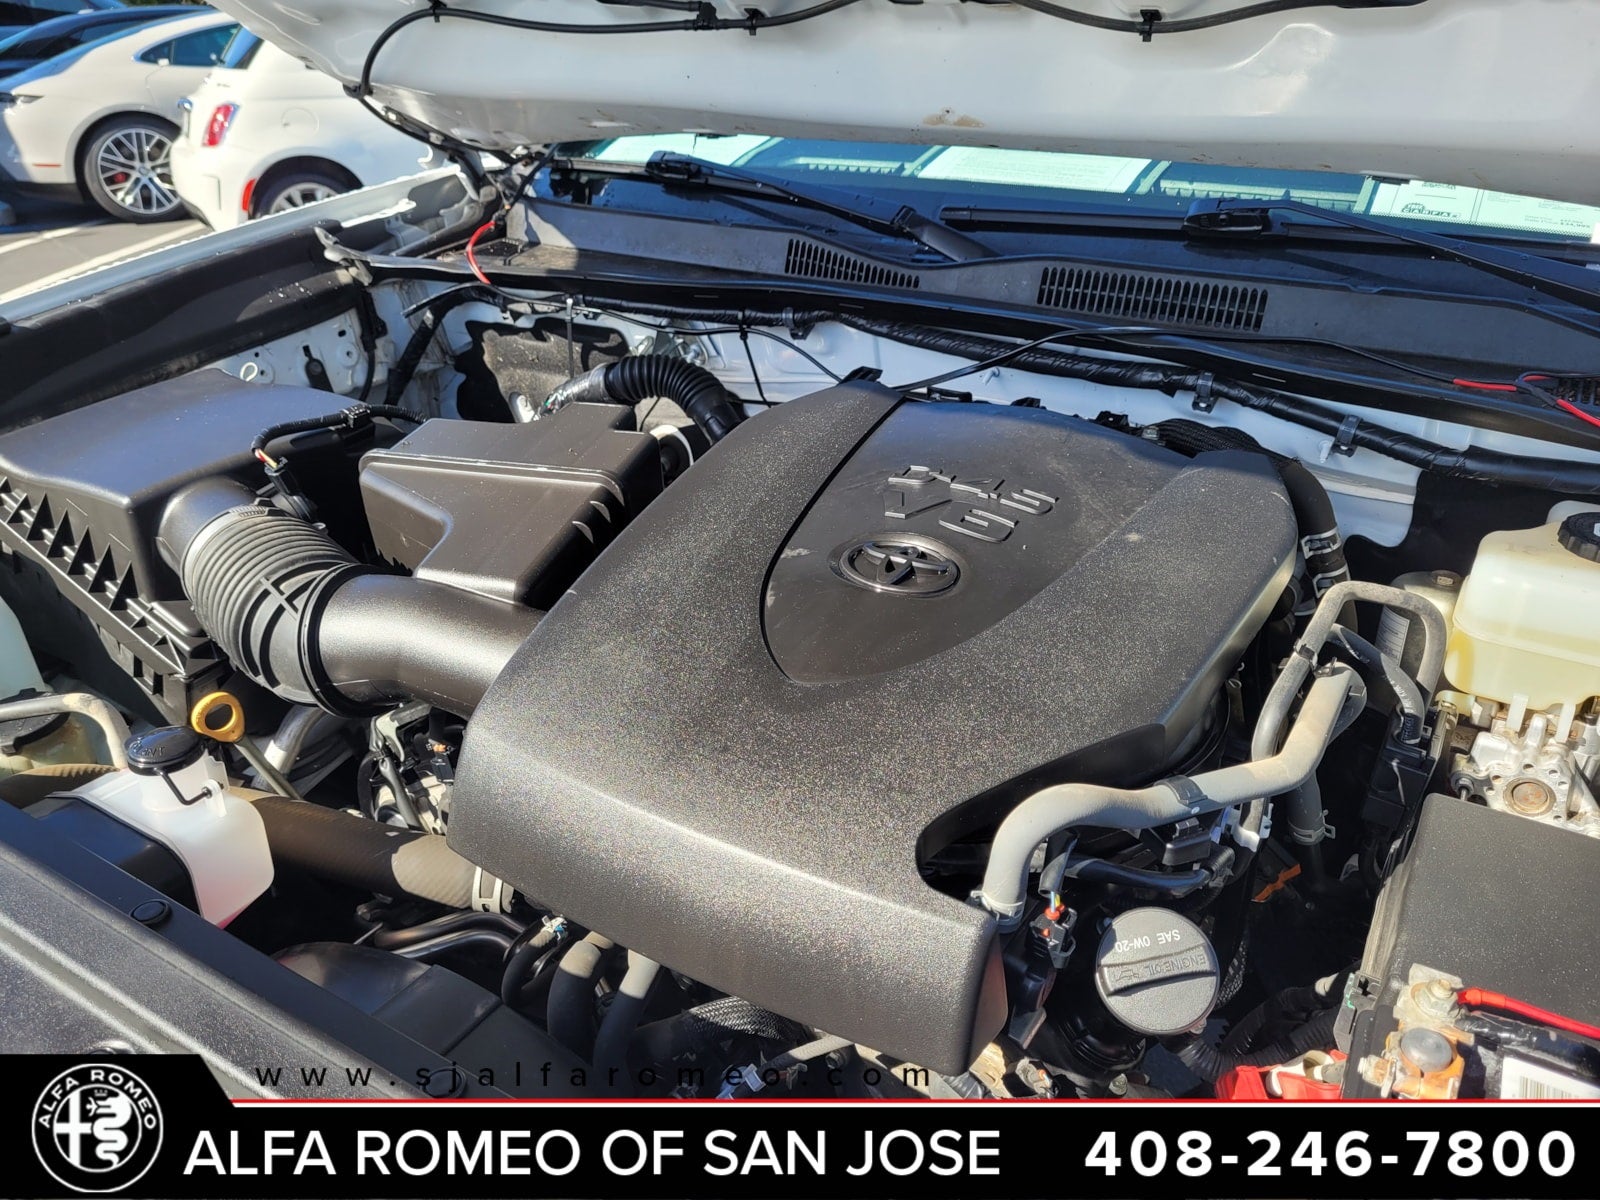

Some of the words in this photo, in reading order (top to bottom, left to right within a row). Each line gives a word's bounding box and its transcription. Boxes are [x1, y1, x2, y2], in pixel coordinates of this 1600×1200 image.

[883, 488, 1020, 543] V6
[1115, 935, 1151, 953] 0W-20
[1156, 929, 1181, 945] SAE
[1145, 963, 1164, 976] OIL
[1164, 955, 1206, 972] ENGINE
